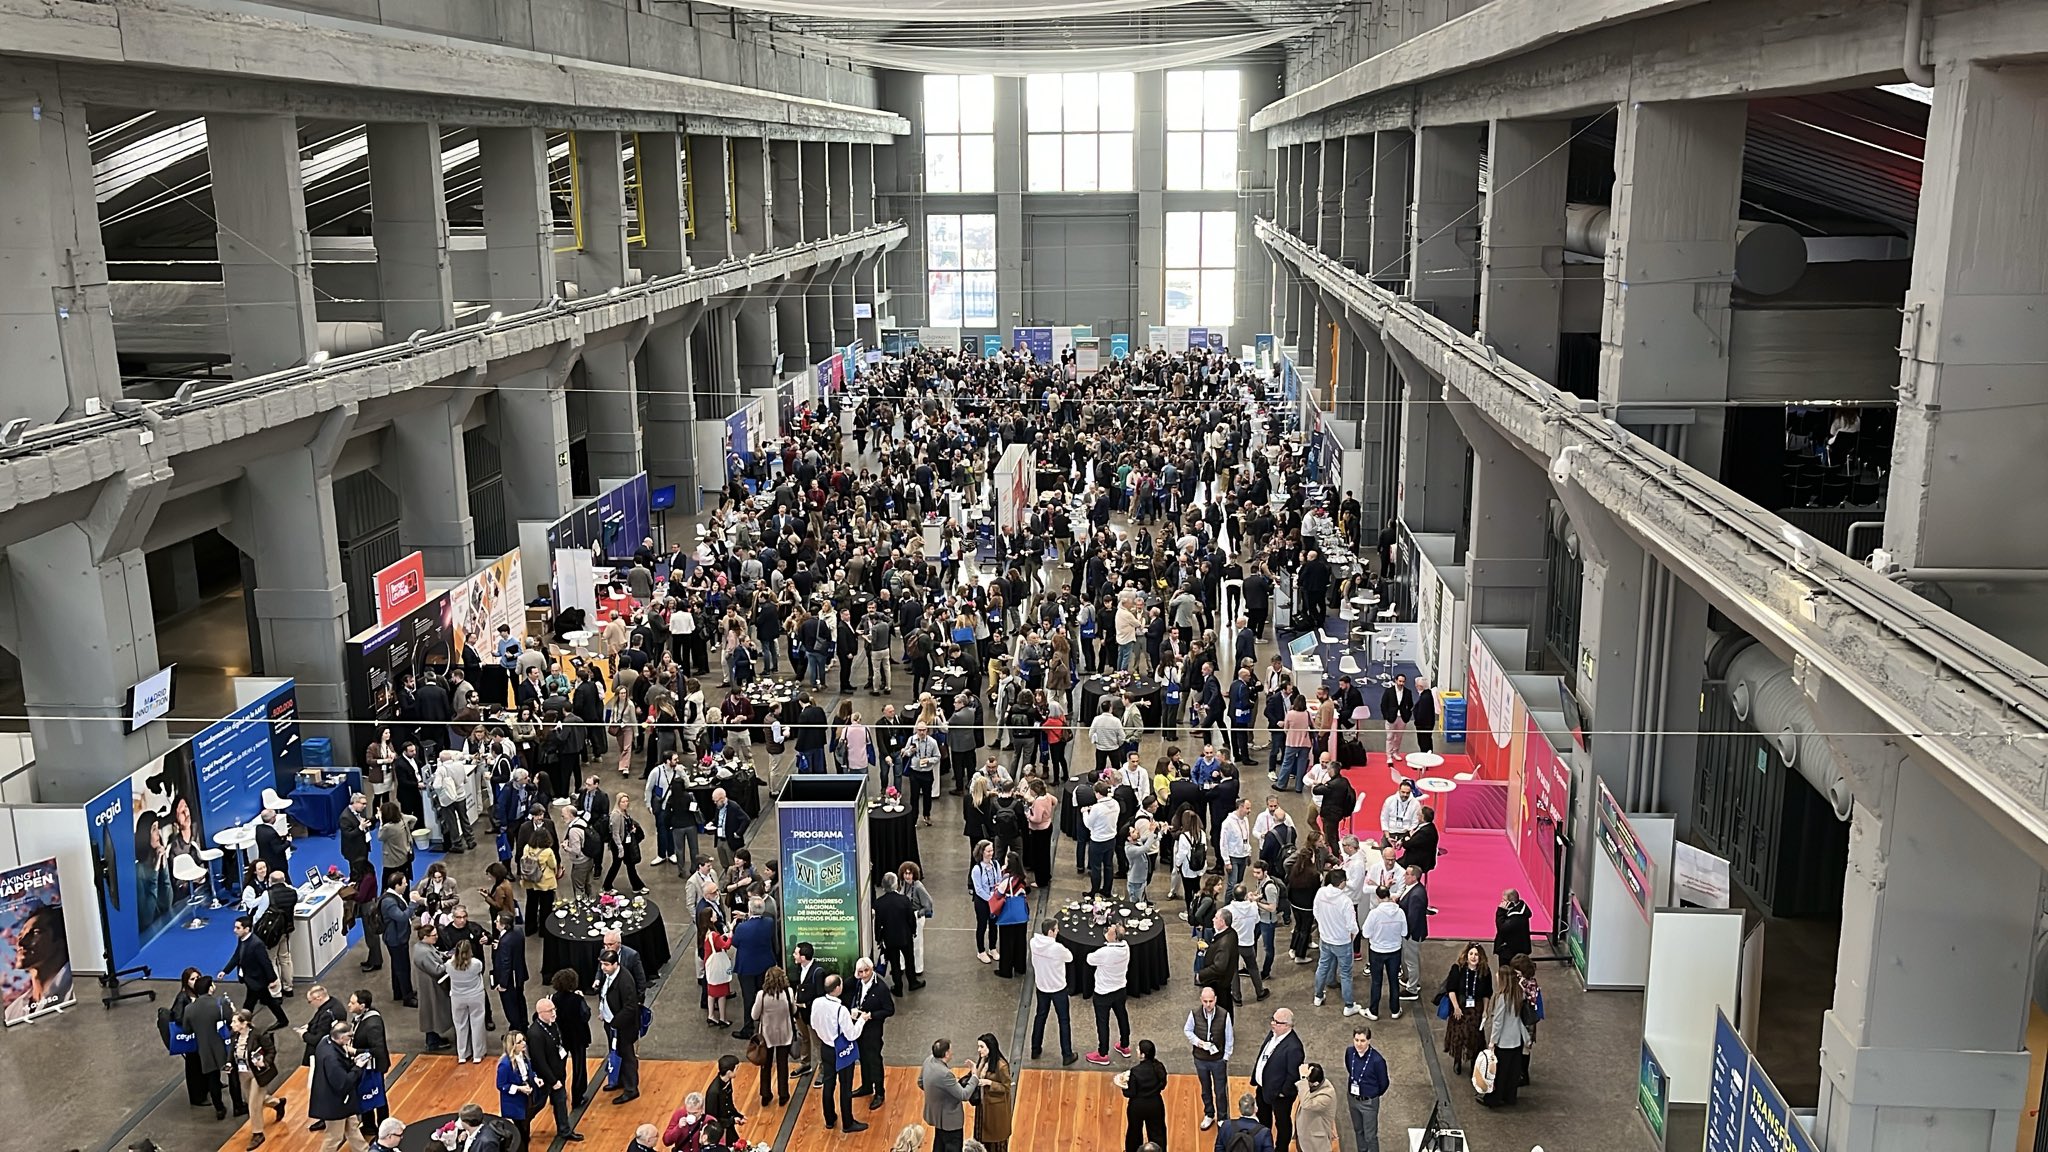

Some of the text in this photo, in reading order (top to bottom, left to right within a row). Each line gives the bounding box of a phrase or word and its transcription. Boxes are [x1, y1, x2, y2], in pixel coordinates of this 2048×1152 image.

[144, 688, 167, 706] MADRID
[95, 797, 122, 827] cegid
[793, 830, 844, 839] PROGRAMA
[0, 868, 42, 888] AKING IT
[796, 861, 815, 887] XVI
[820, 862, 842, 880] CNIS
[824, 914, 855, 922] PÚBLICOS
[318, 918, 340, 946] cegid
[1750, 1103, 1766, 1135] PARA
[1766, 1128, 1780, 1152] LOS
[1752, 1084, 1799, 1152] TRANSFOR
